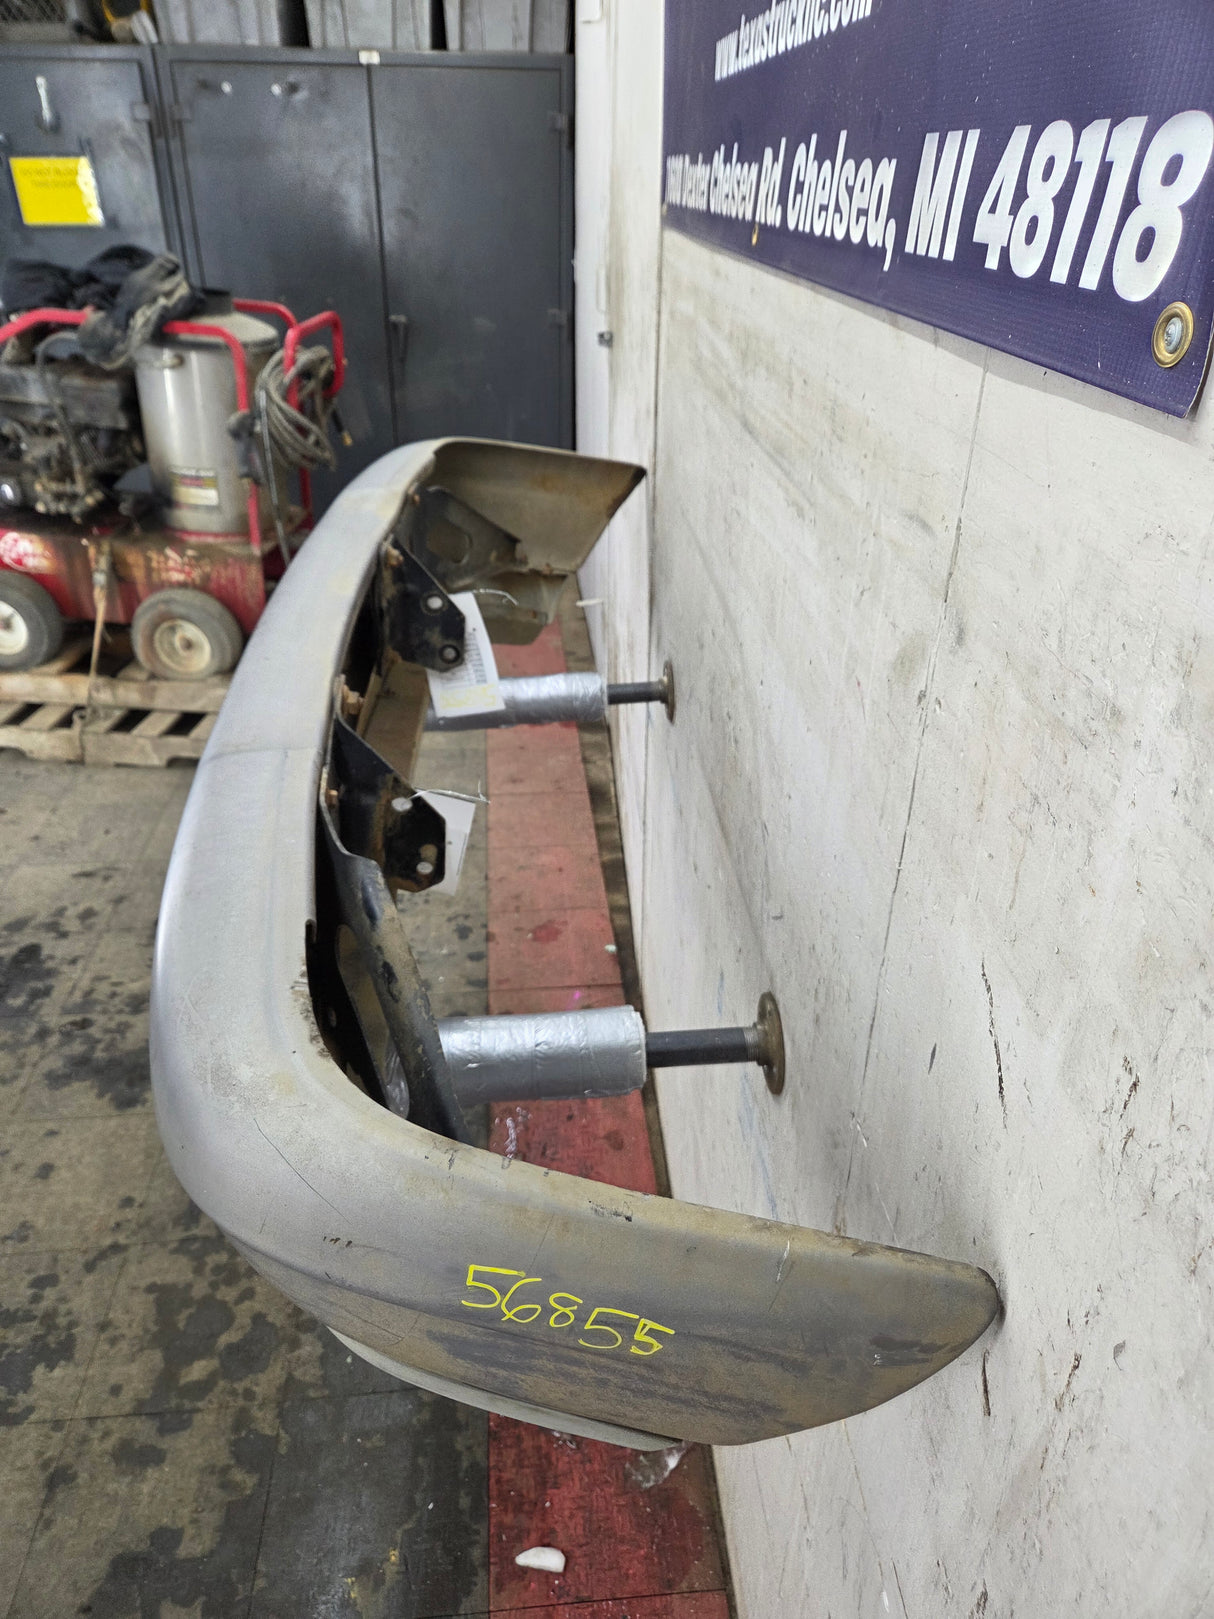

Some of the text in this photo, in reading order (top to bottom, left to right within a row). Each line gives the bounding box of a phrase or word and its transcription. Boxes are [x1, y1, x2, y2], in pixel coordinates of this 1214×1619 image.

[714, 0, 873, 82] www.texastruckllc.c
[710, 142, 759, 222] Chelsea
[756, 136, 786, 229] Rd.
[787, 129, 897, 272] Chelsea,
[904, 128, 981, 261] MI
[973, 109, 1213, 302] 48118
[461, 1263, 675, 1356] 56855
